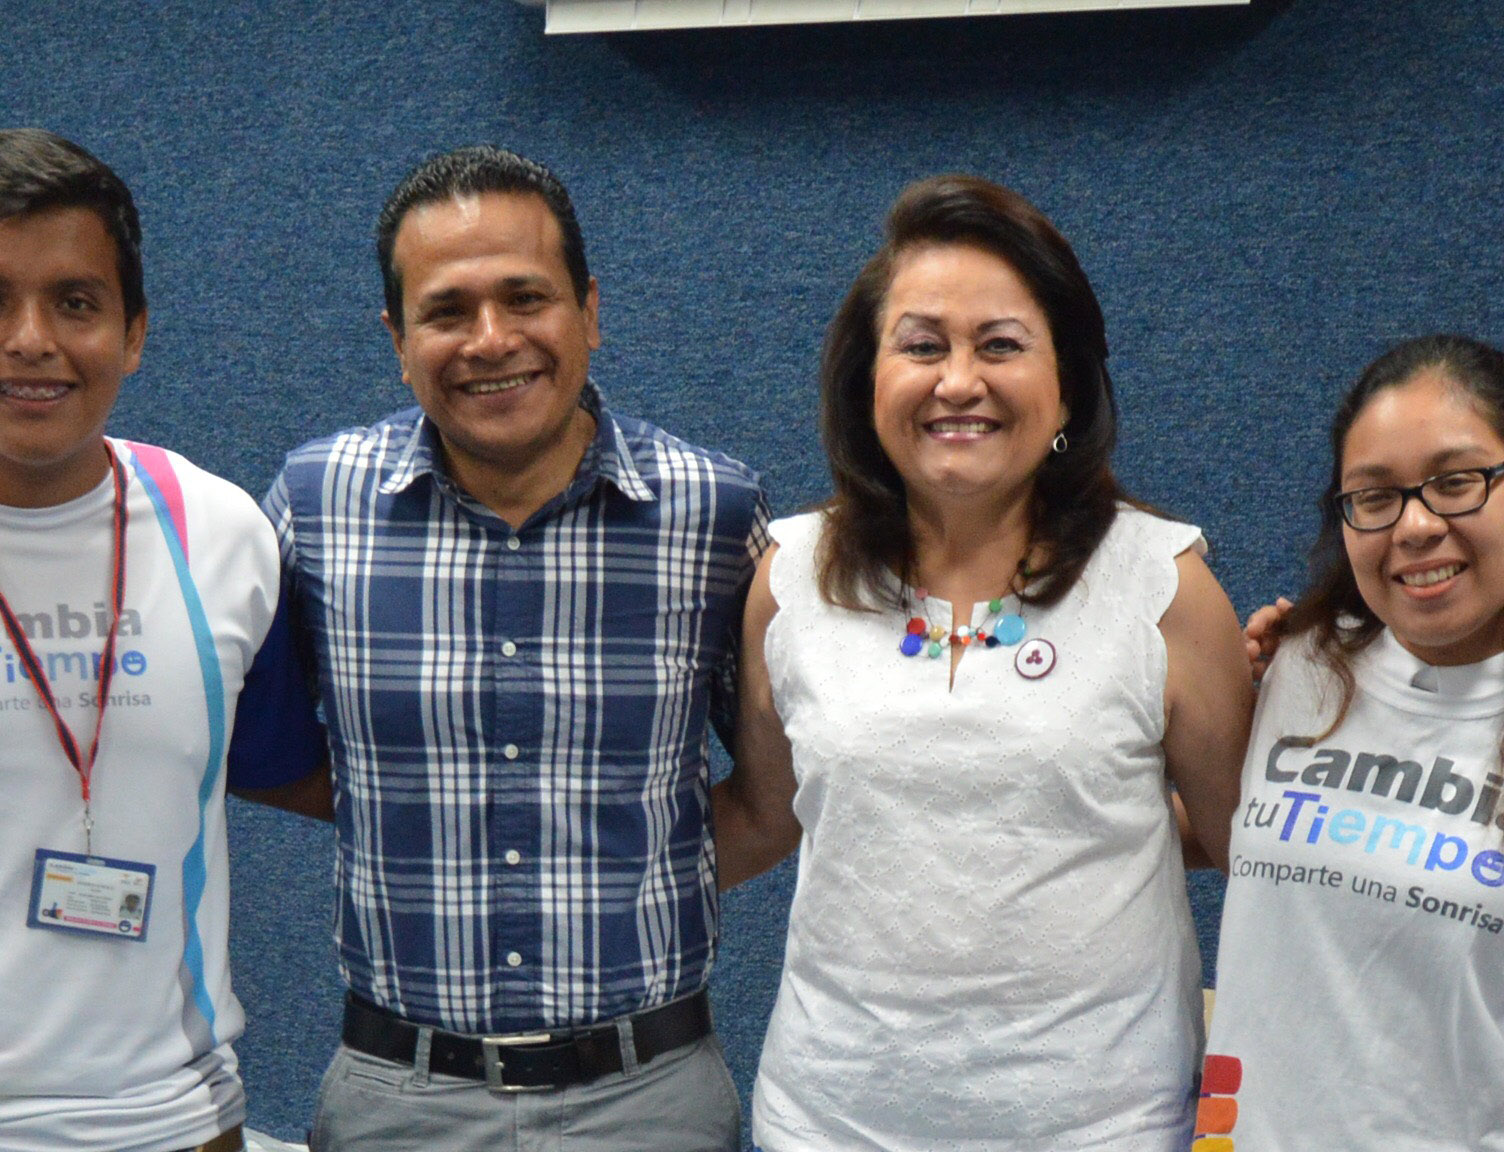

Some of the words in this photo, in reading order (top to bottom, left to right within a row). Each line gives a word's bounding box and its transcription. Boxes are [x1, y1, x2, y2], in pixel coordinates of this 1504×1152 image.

[1243, 796, 1281, 829] tu
[1232, 855, 1343, 888] Comparte
[1351, 872, 1398, 903] una
